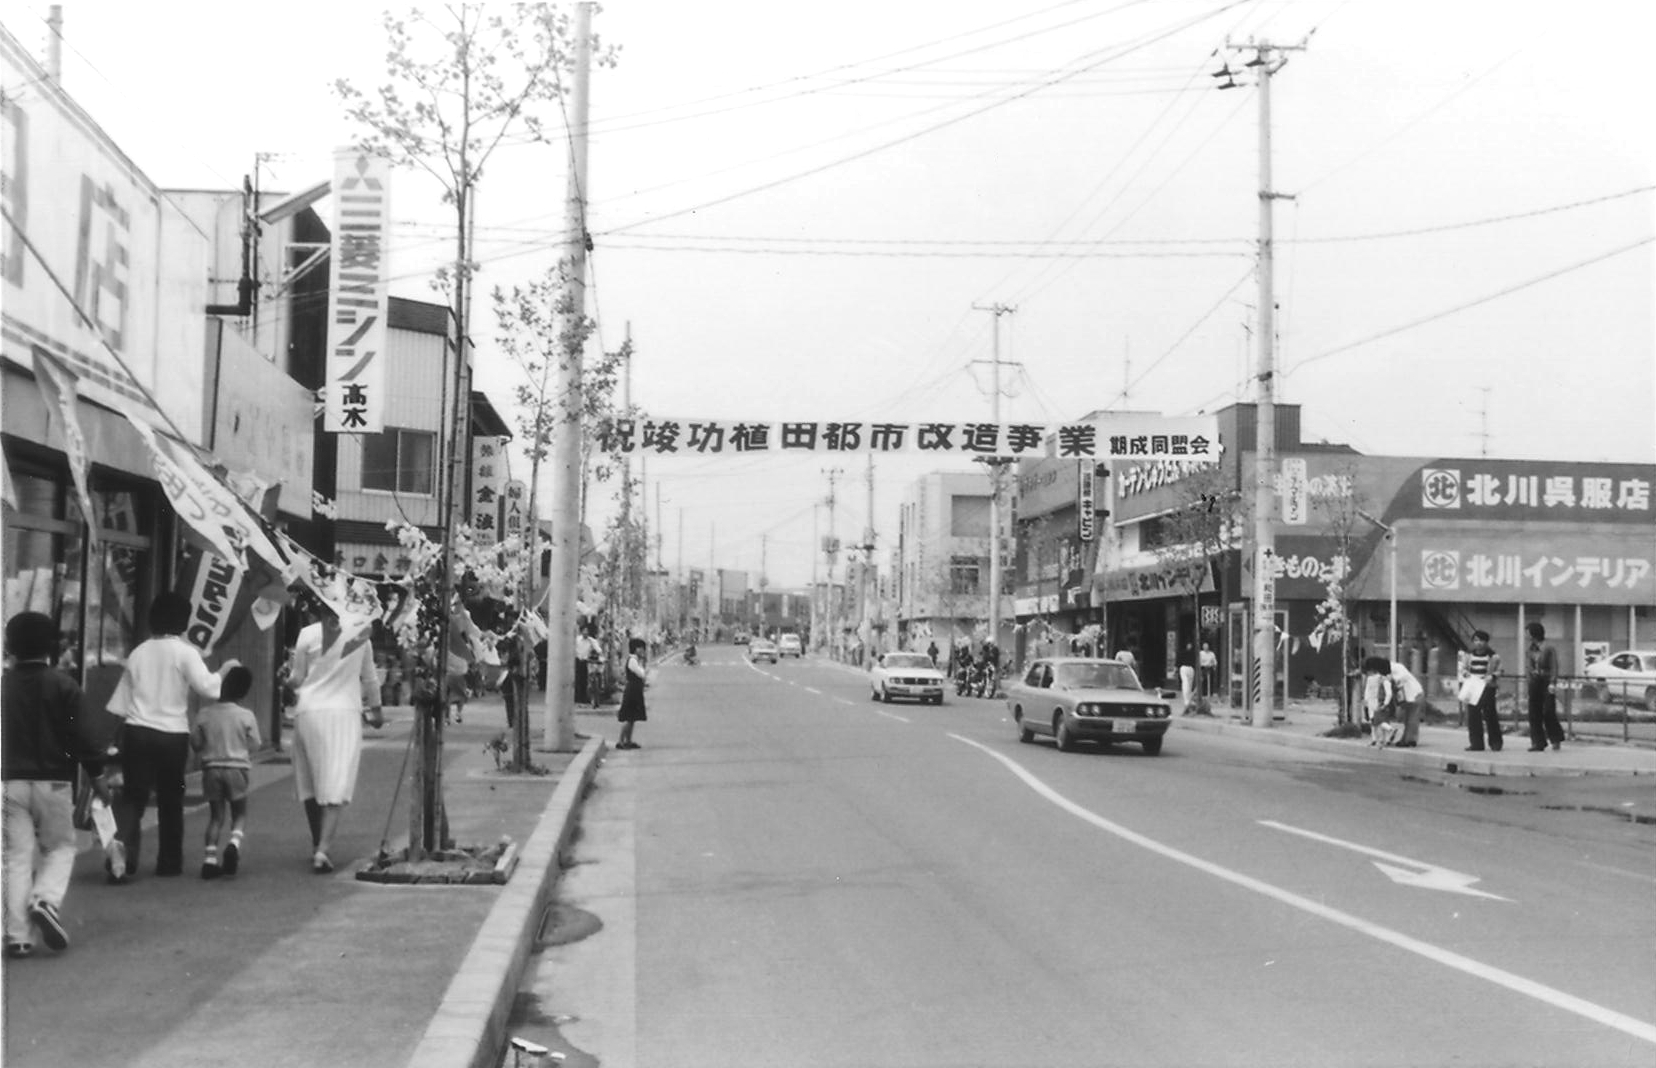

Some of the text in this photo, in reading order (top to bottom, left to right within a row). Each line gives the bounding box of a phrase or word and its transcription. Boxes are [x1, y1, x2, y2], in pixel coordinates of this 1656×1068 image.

[335, 195, 382, 428] 三菱ミシン 高木
[1109, 435, 1210, 455] 期成同盟会
[1466, 474, 1650, 510] 北川呉服店
[1466, 554, 1650, 588] 北川インテリア
